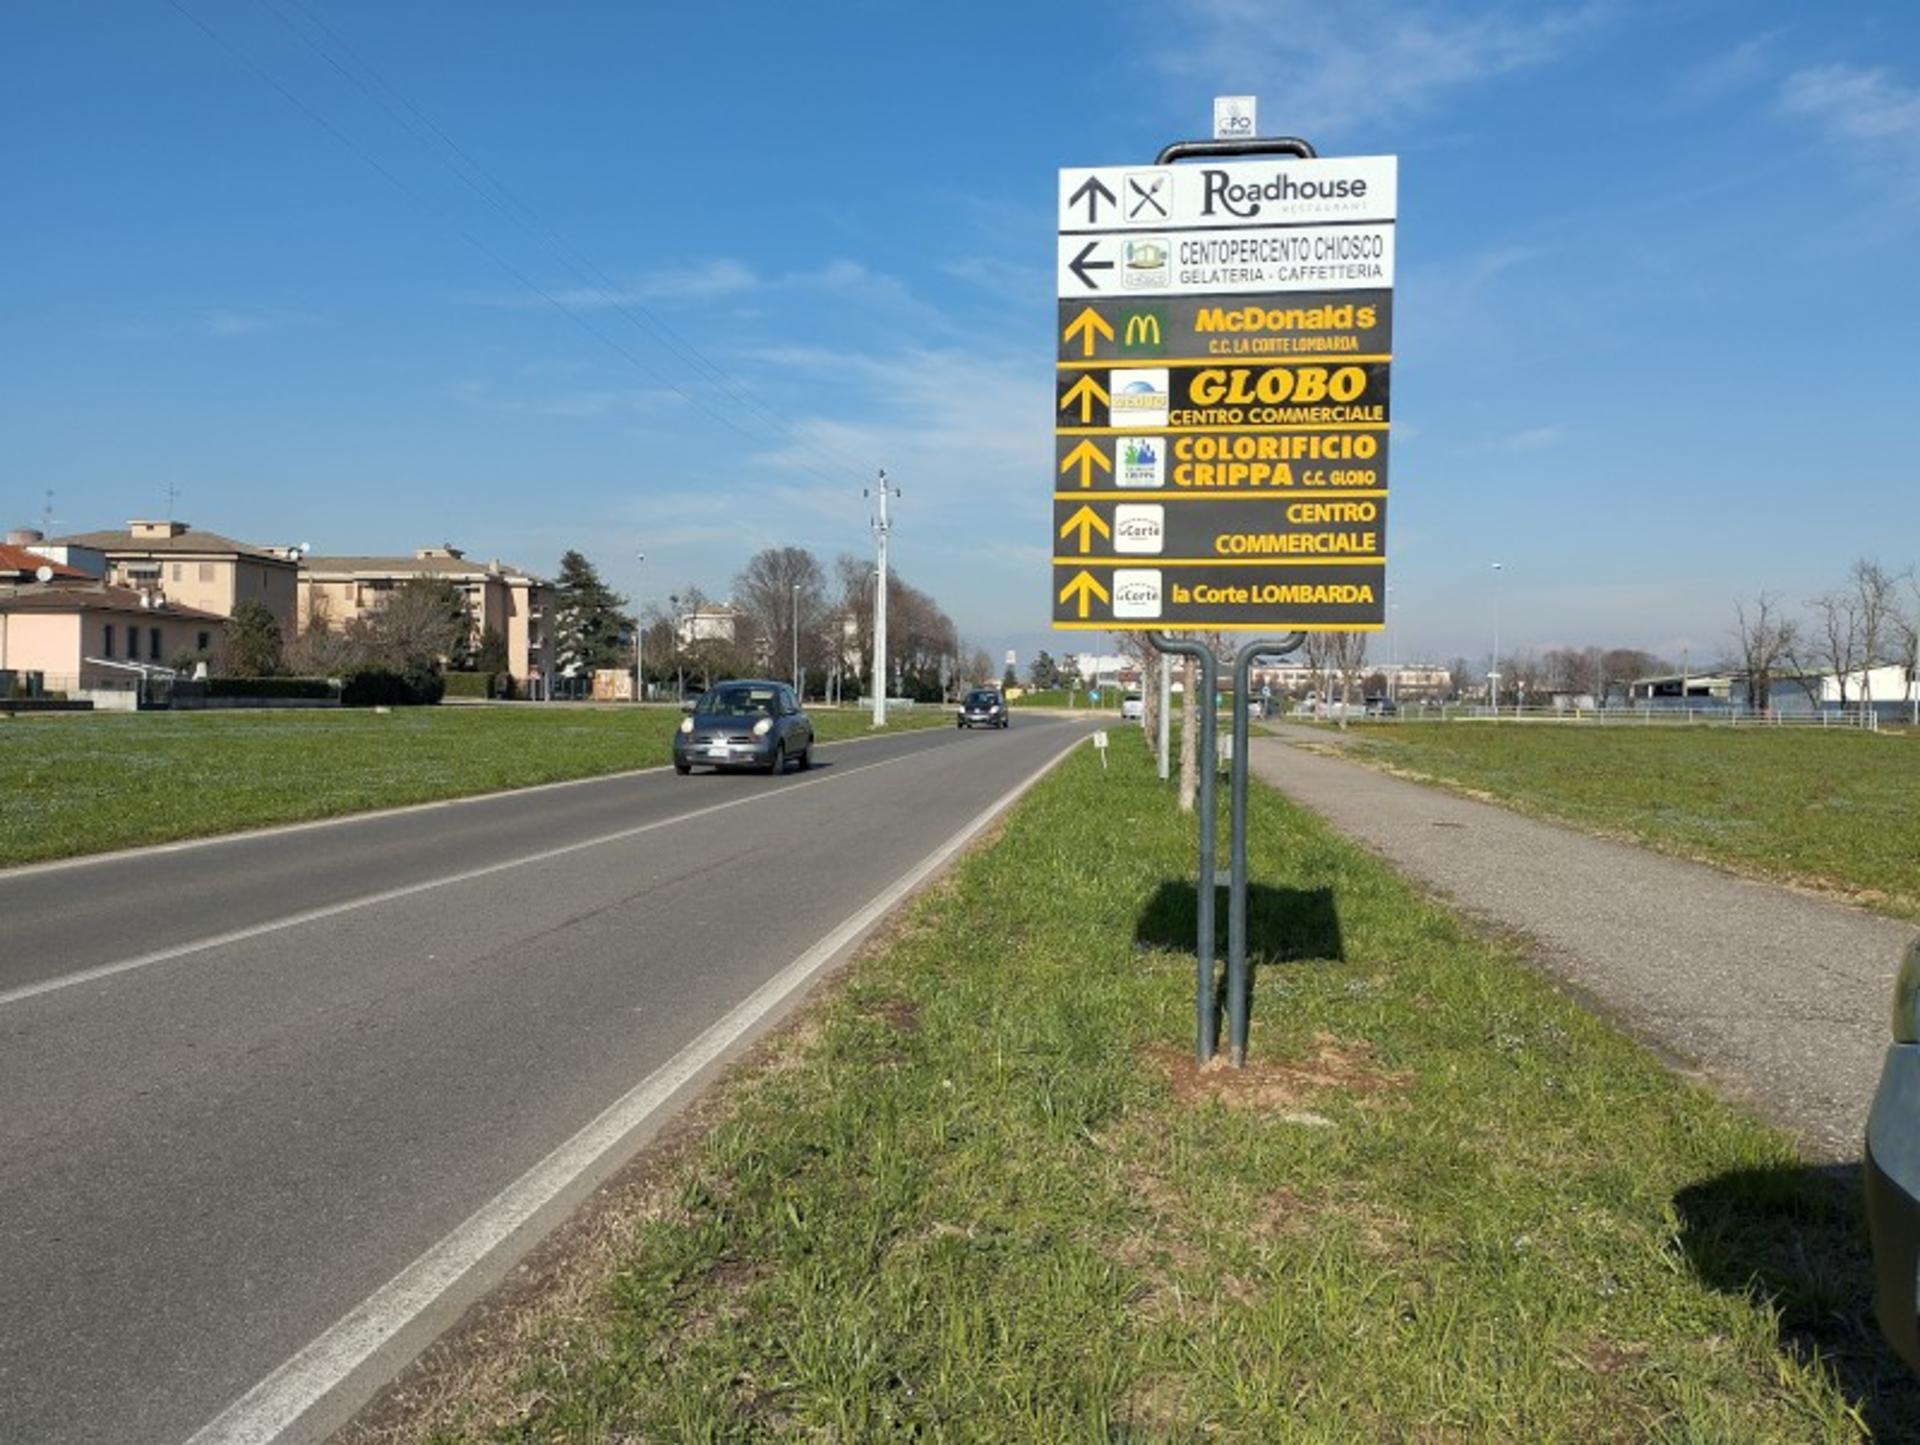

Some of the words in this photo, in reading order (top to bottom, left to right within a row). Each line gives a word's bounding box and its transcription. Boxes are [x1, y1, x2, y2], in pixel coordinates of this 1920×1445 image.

[1200, 169, 1367, 218] Roadhouse
[1180, 239, 1310, 266] CENTOPERCENTO
[1315, 234, 1383, 260] CHIOSCO
[1180, 267, 1265, 285] GELATERIA
[1278, 263, 1383, 282] CAFFETTERIA
[1189, 366, 1367, 406] GLOBO
[1169, 408, 1243, 425] CENTRO
[1249, 404, 1384, 424] COMMERCIALE
[1173, 434, 1378, 461] COLORIFICIO
[1173, 462, 1294, 487] CRIPPA
[1286, 502, 1376, 523] CENTRO
[1215, 532, 1376, 554] COMMERCIALE
[1172, 583, 1190, 604] la
[1193, 584, 1248, 604] Corte
[1252, 584, 1374, 604] LOMBARDA
